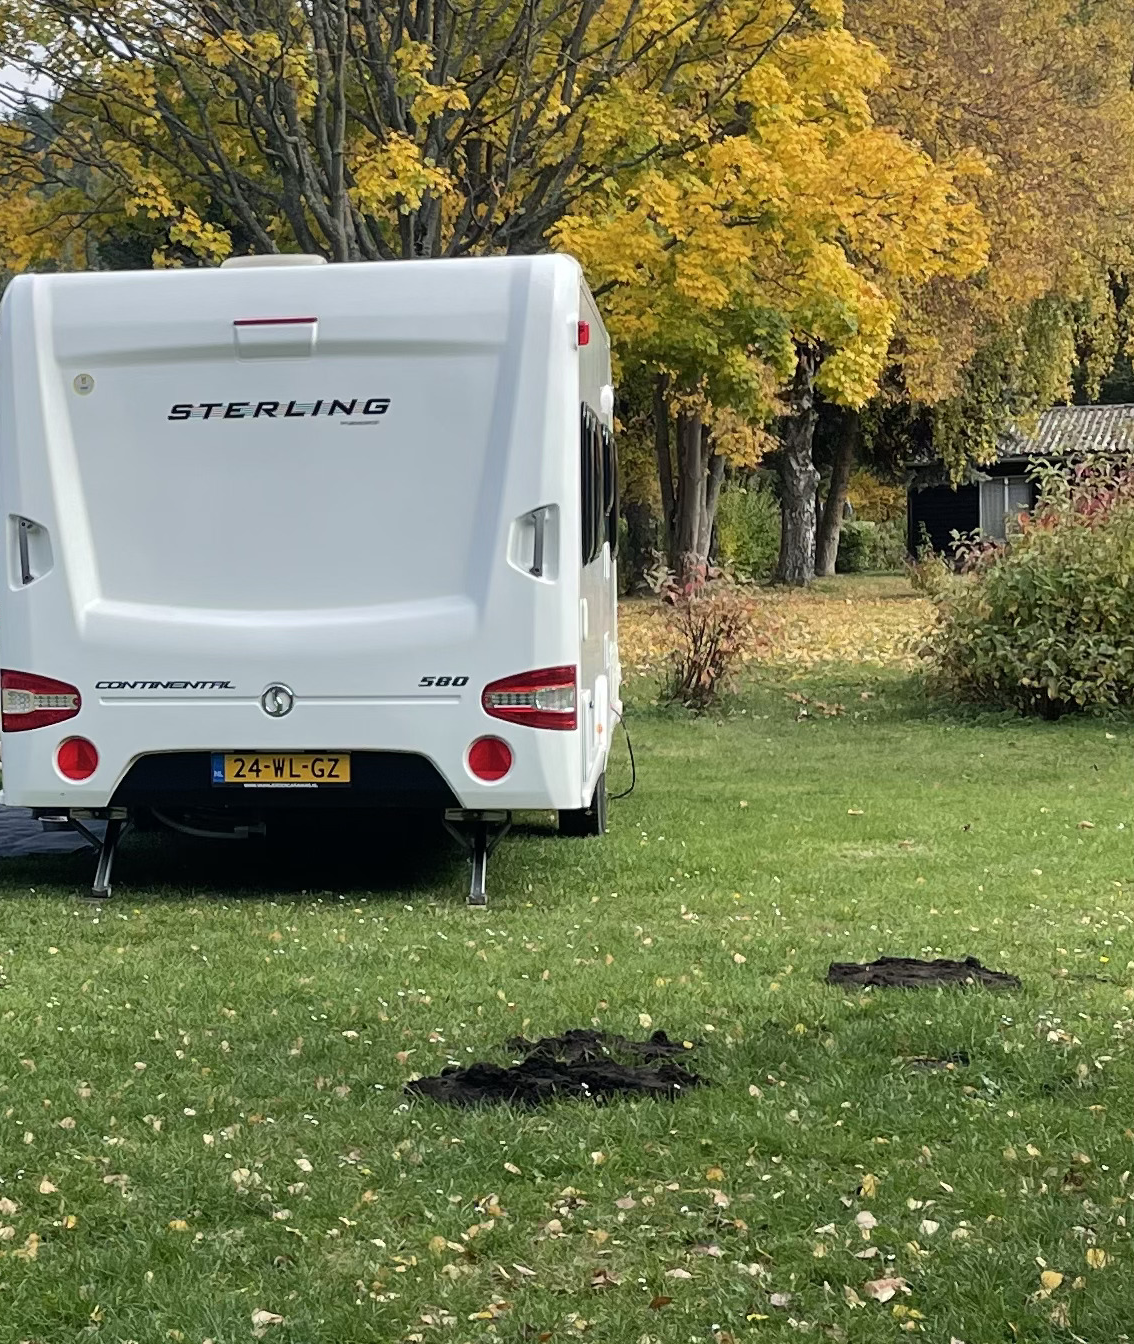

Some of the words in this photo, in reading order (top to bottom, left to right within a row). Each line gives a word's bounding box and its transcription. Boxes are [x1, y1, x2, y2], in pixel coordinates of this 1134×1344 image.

[167, 398, 391, 420] STERLING
[95, 680, 236, 690] CONTINENTAL
[417, 676, 470, 687] 580
[233, 757, 340, 778] 24-WL-GZ
